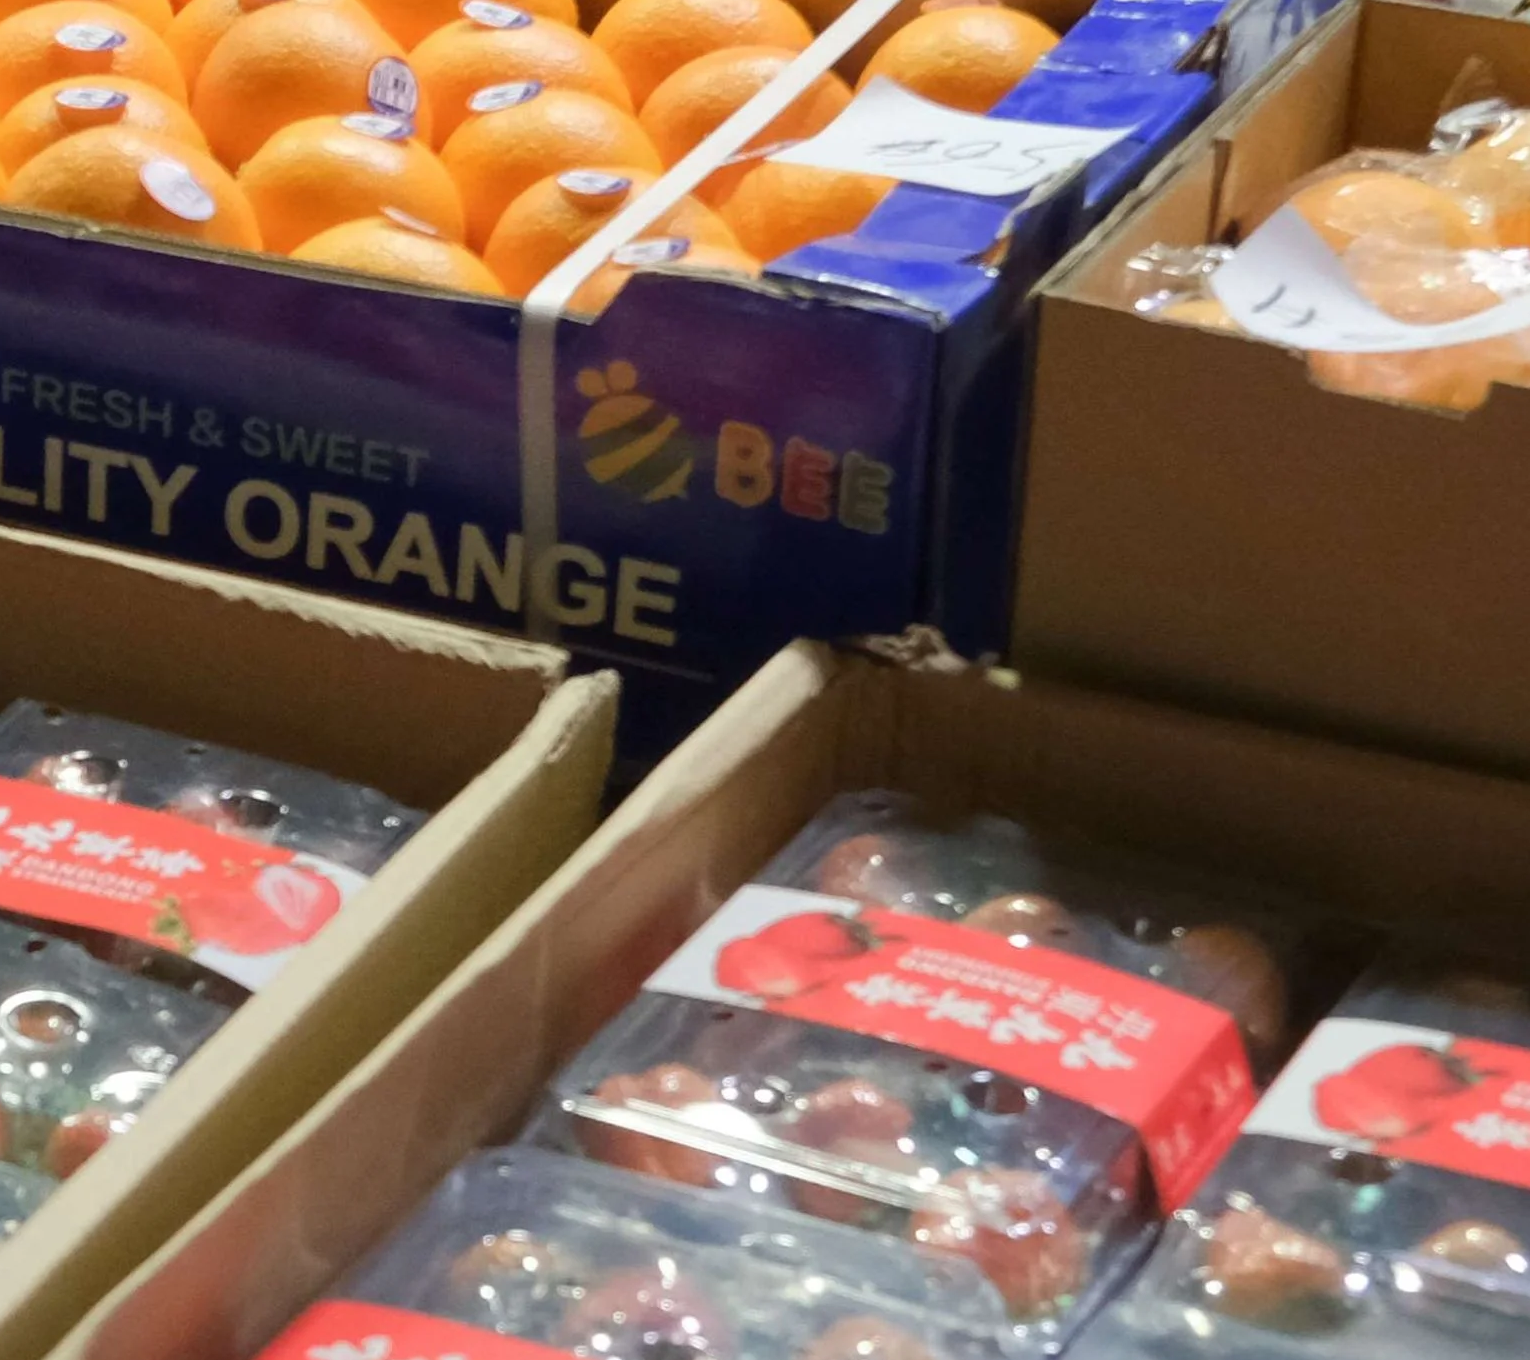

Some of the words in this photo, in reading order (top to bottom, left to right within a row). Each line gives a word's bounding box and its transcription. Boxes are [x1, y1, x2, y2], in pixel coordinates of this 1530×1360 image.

[0, 367, 174, 441] FRESH
[188, 407, 226, 448] &
[240, 416, 431, 495] SWEET
[713, 420, 895, 537] BEE
[223, 479, 682, 645] ORANGE
